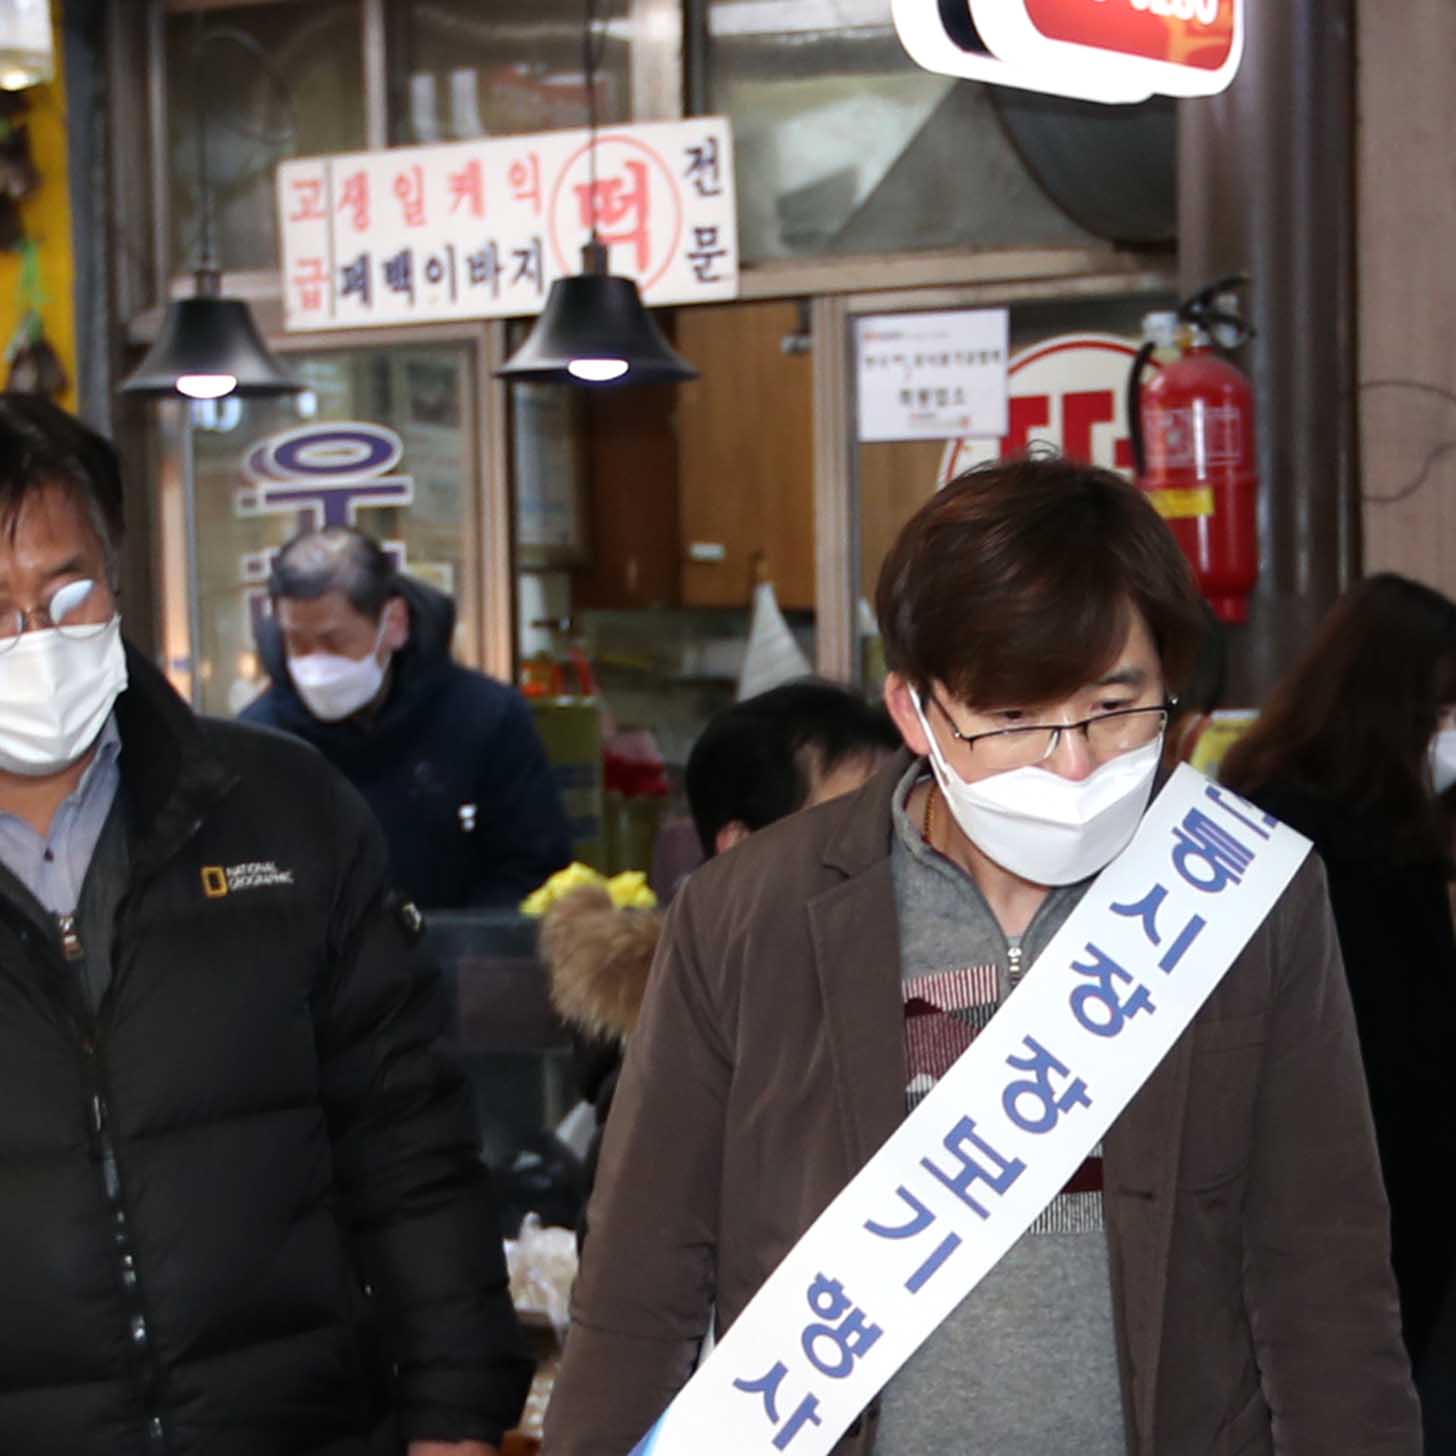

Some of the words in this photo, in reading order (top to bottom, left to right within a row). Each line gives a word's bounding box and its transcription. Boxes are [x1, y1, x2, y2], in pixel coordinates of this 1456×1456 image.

[574, 158, 651, 273] 떡
[683, 136, 729, 285] 전문
[864, 1035, 1092, 1294] 장보기
[735, 1273, 883, 1450] 행사
